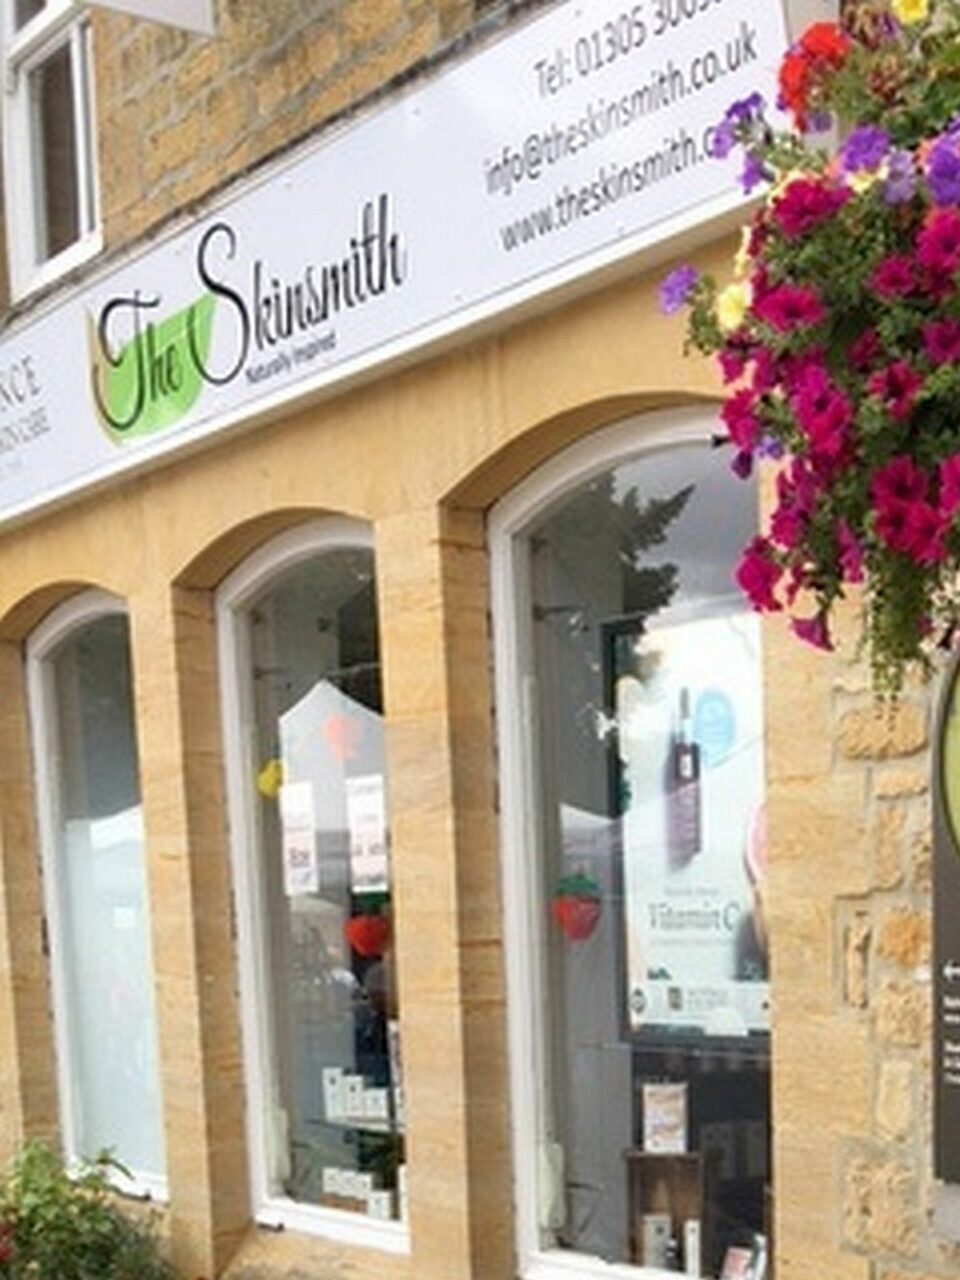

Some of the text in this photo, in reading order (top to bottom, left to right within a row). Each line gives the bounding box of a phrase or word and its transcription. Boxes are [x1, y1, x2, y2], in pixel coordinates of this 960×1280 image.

[484, 21, 757, 195] info@theskinsmith.co.uk
[534, 50, 572, 97] Tel:
[574, 5, 647, 76] 01305
[500, 126, 716, 251] www.theskinsmith.c
[92, 193, 408, 431] The Skinsmith
